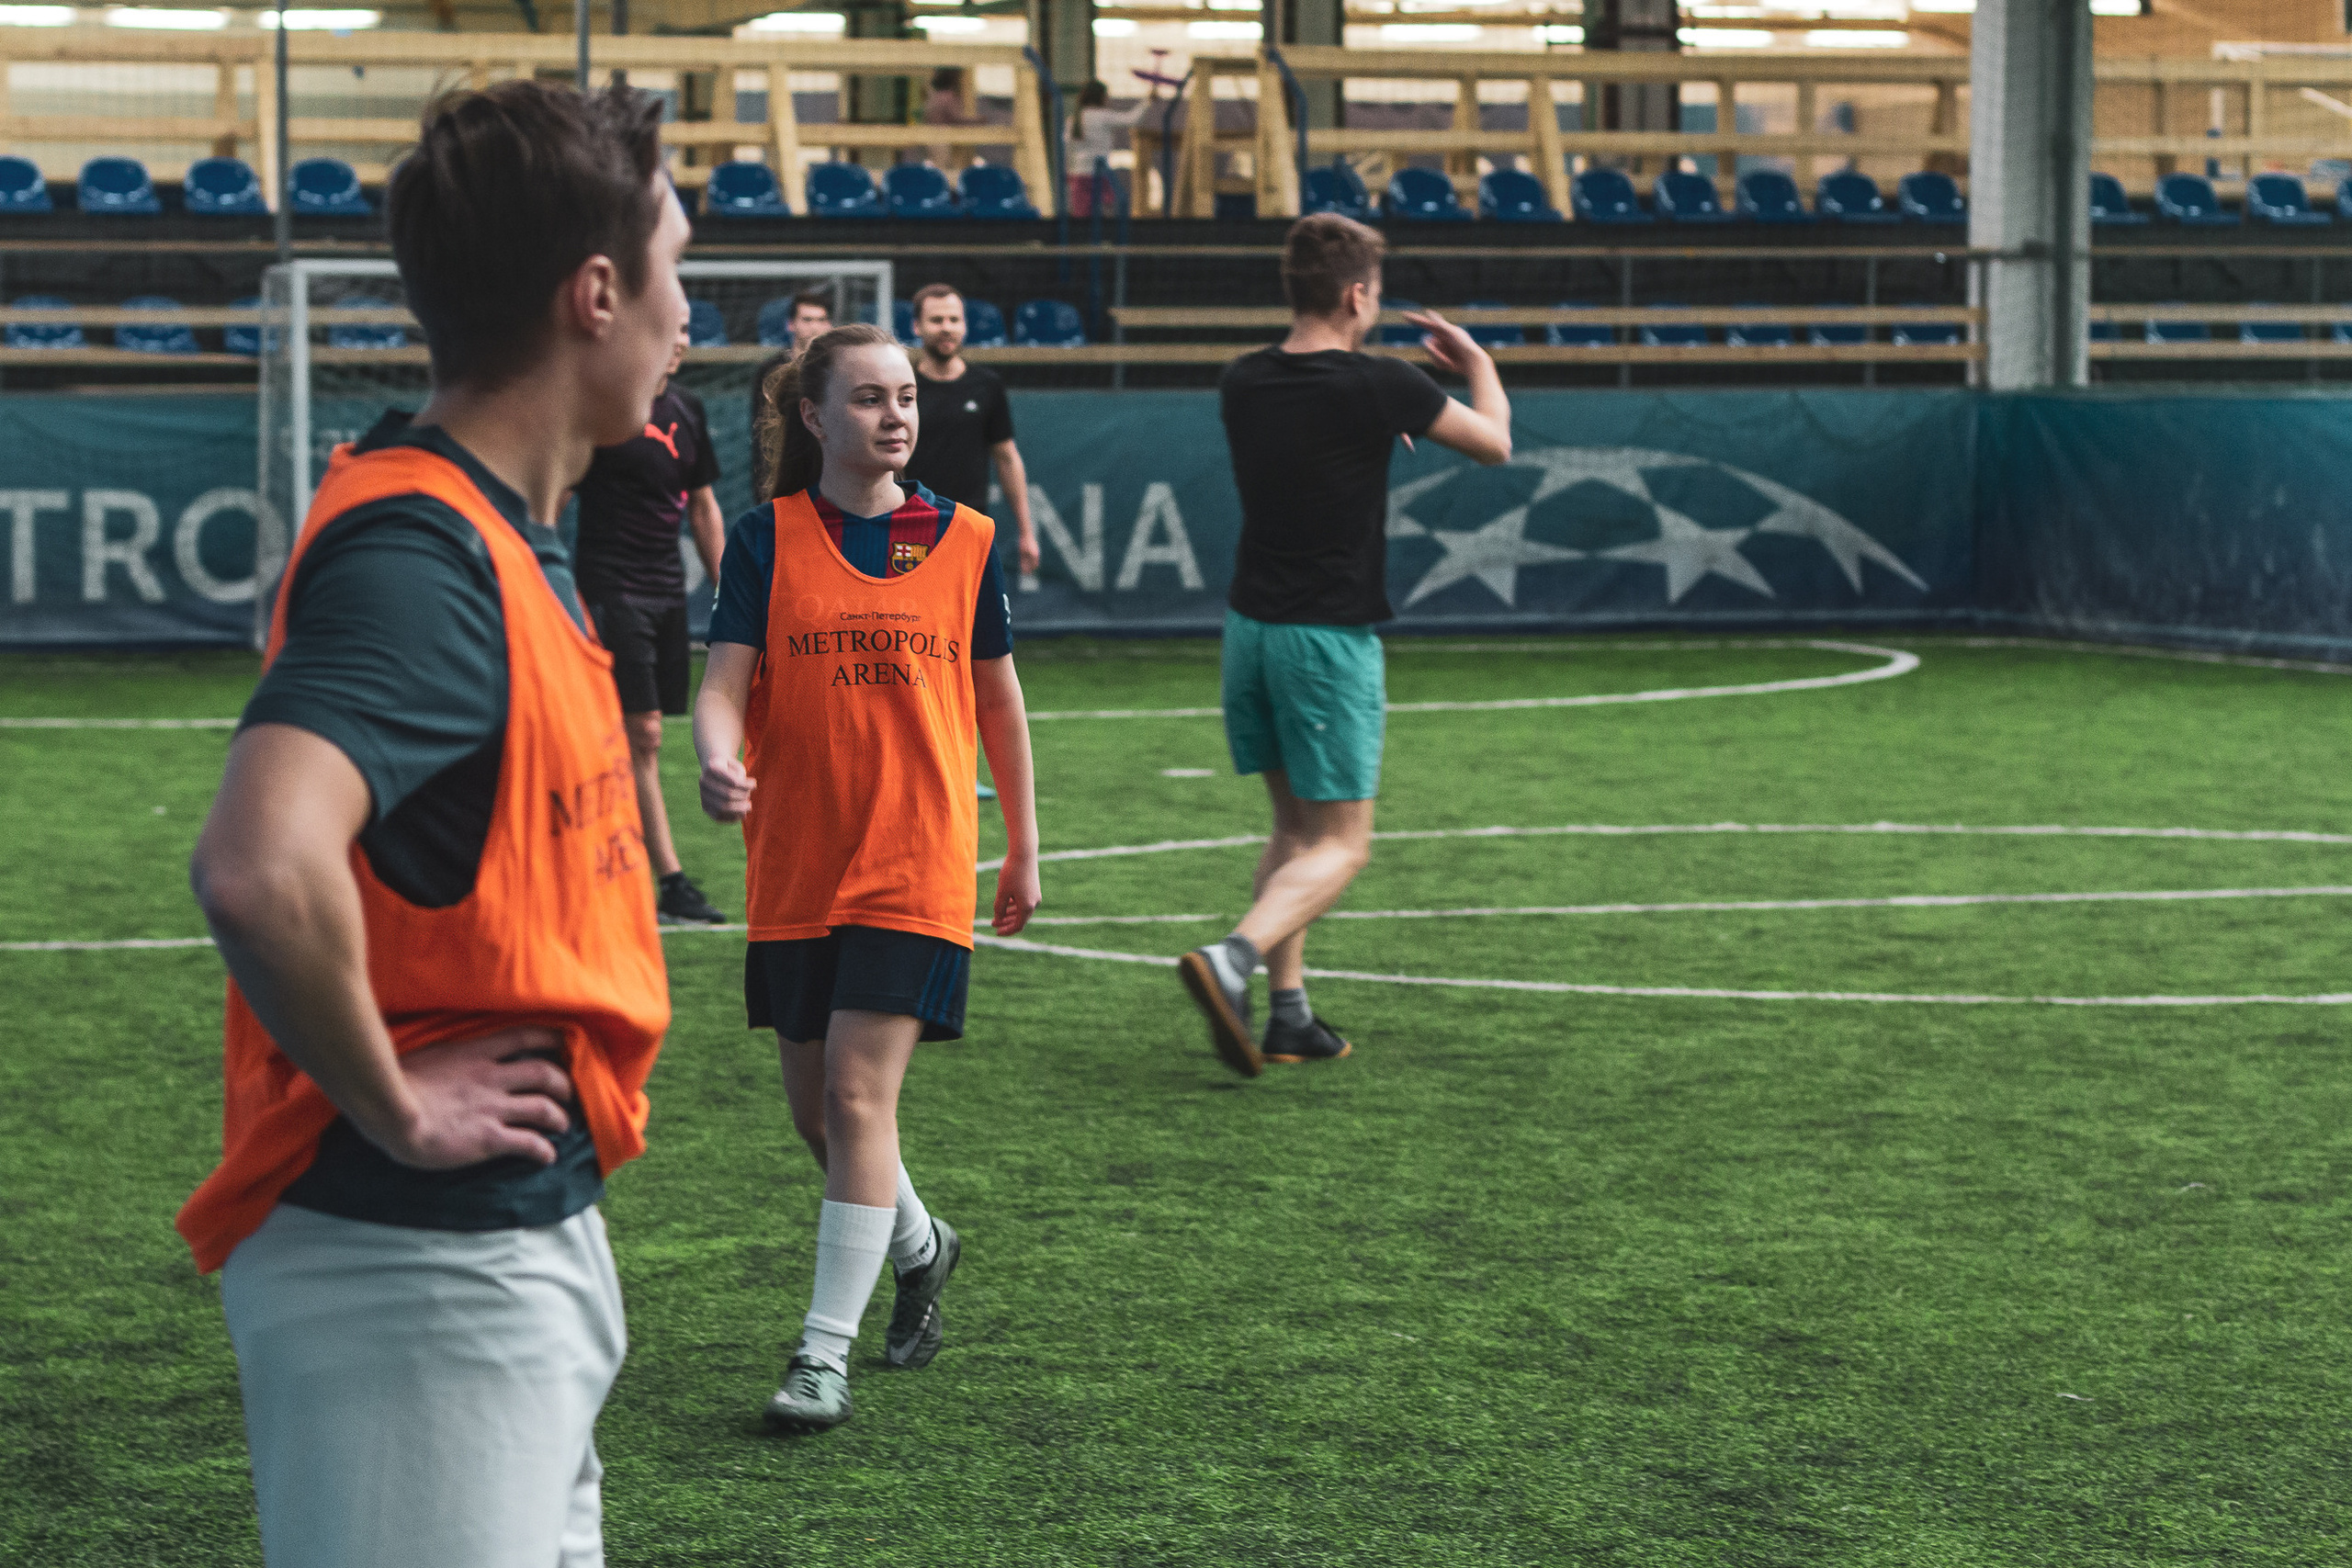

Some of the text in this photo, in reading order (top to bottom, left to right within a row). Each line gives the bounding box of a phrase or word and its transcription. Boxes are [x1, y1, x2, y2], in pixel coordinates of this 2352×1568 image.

[0, 489, 287, 604] TRO
[989, 482, 1205, 592] NA
[787, 629, 960, 663] METROPOLIS
[831, 662, 927, 688] ARENA
